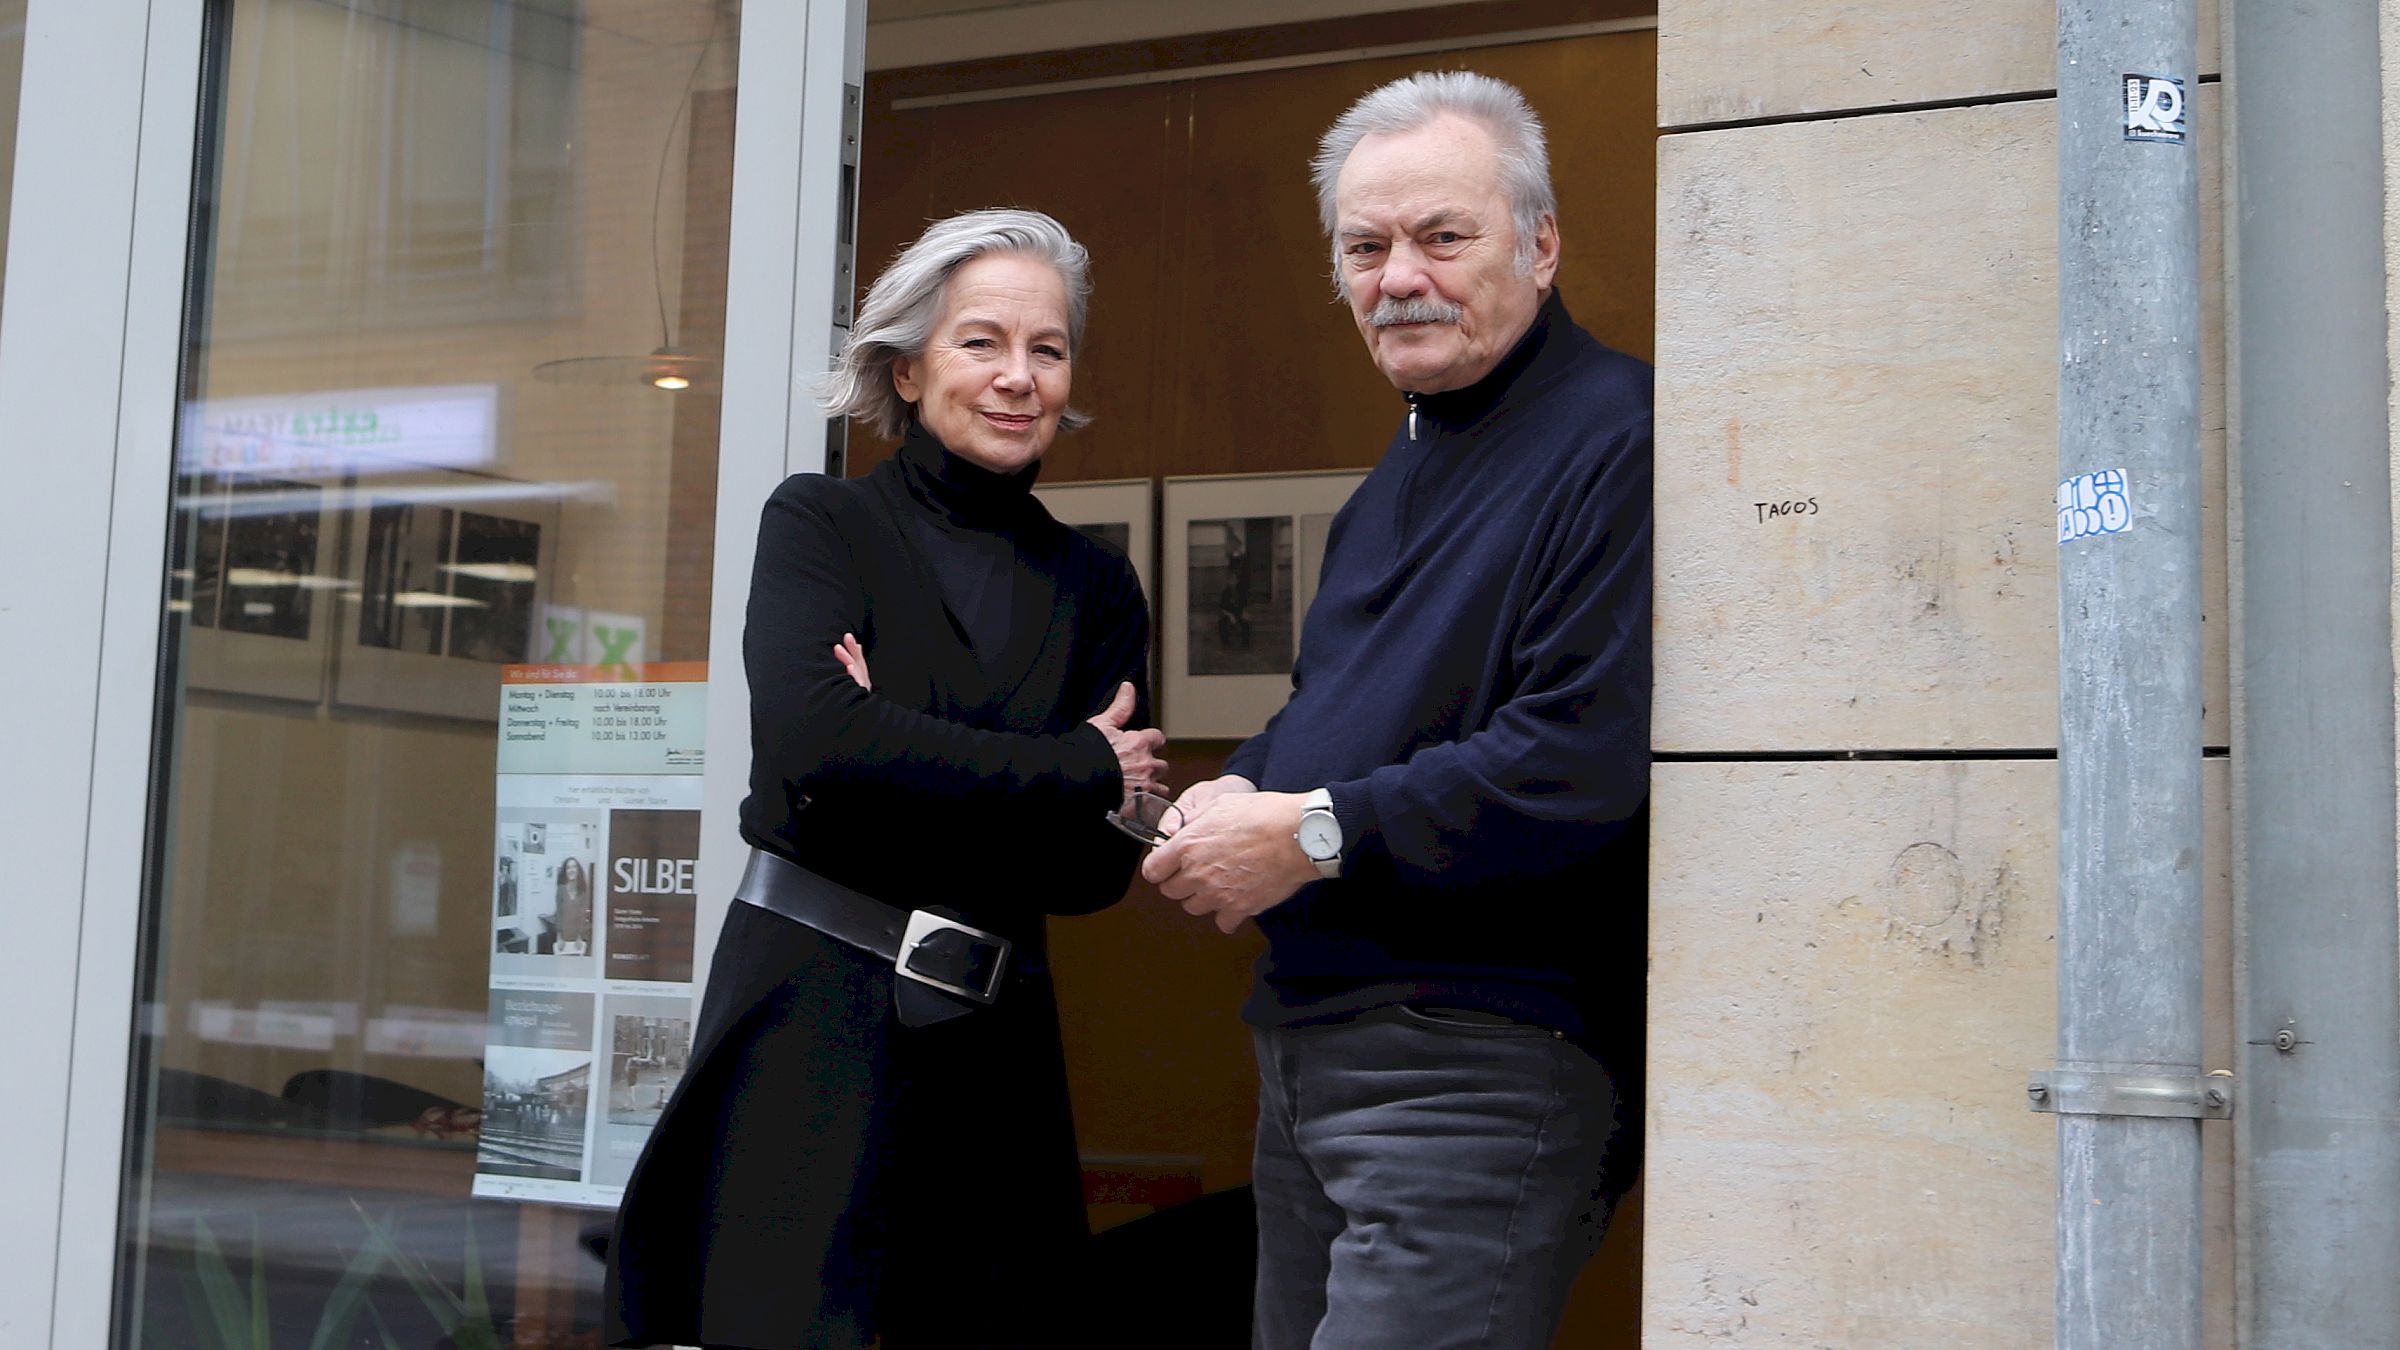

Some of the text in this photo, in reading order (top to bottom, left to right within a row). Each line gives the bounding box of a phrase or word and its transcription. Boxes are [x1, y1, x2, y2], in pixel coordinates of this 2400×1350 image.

[1754, 497, 1819, 524] TACOS
[509, 690, 535, 702] Montag
[544, 689, 575, 702] Dienstag
[594, 688, 615, 699] 10.00
[620, 688, 631, 699] bis
[634, 688, 656, 698] 18.00
[658, 688, 672, 698] Uhr
[508, 702, 661, 715] Mittwoch nach Vereinbarung
[507, 717, 546, 729] Donnerstag
[555, 717, 579, 729] Freitag
[592, 716, 614, 727] 10.00
[616, 716, 627, 727] bis
[630, 716, 652, 727] 18.00
[654, 716, 668, 726] Uhr
[506, 730, 667, 741] Sonnabend 10.00 bis 13.00 Uhr
[613, 856, 699, 895] SILBE
